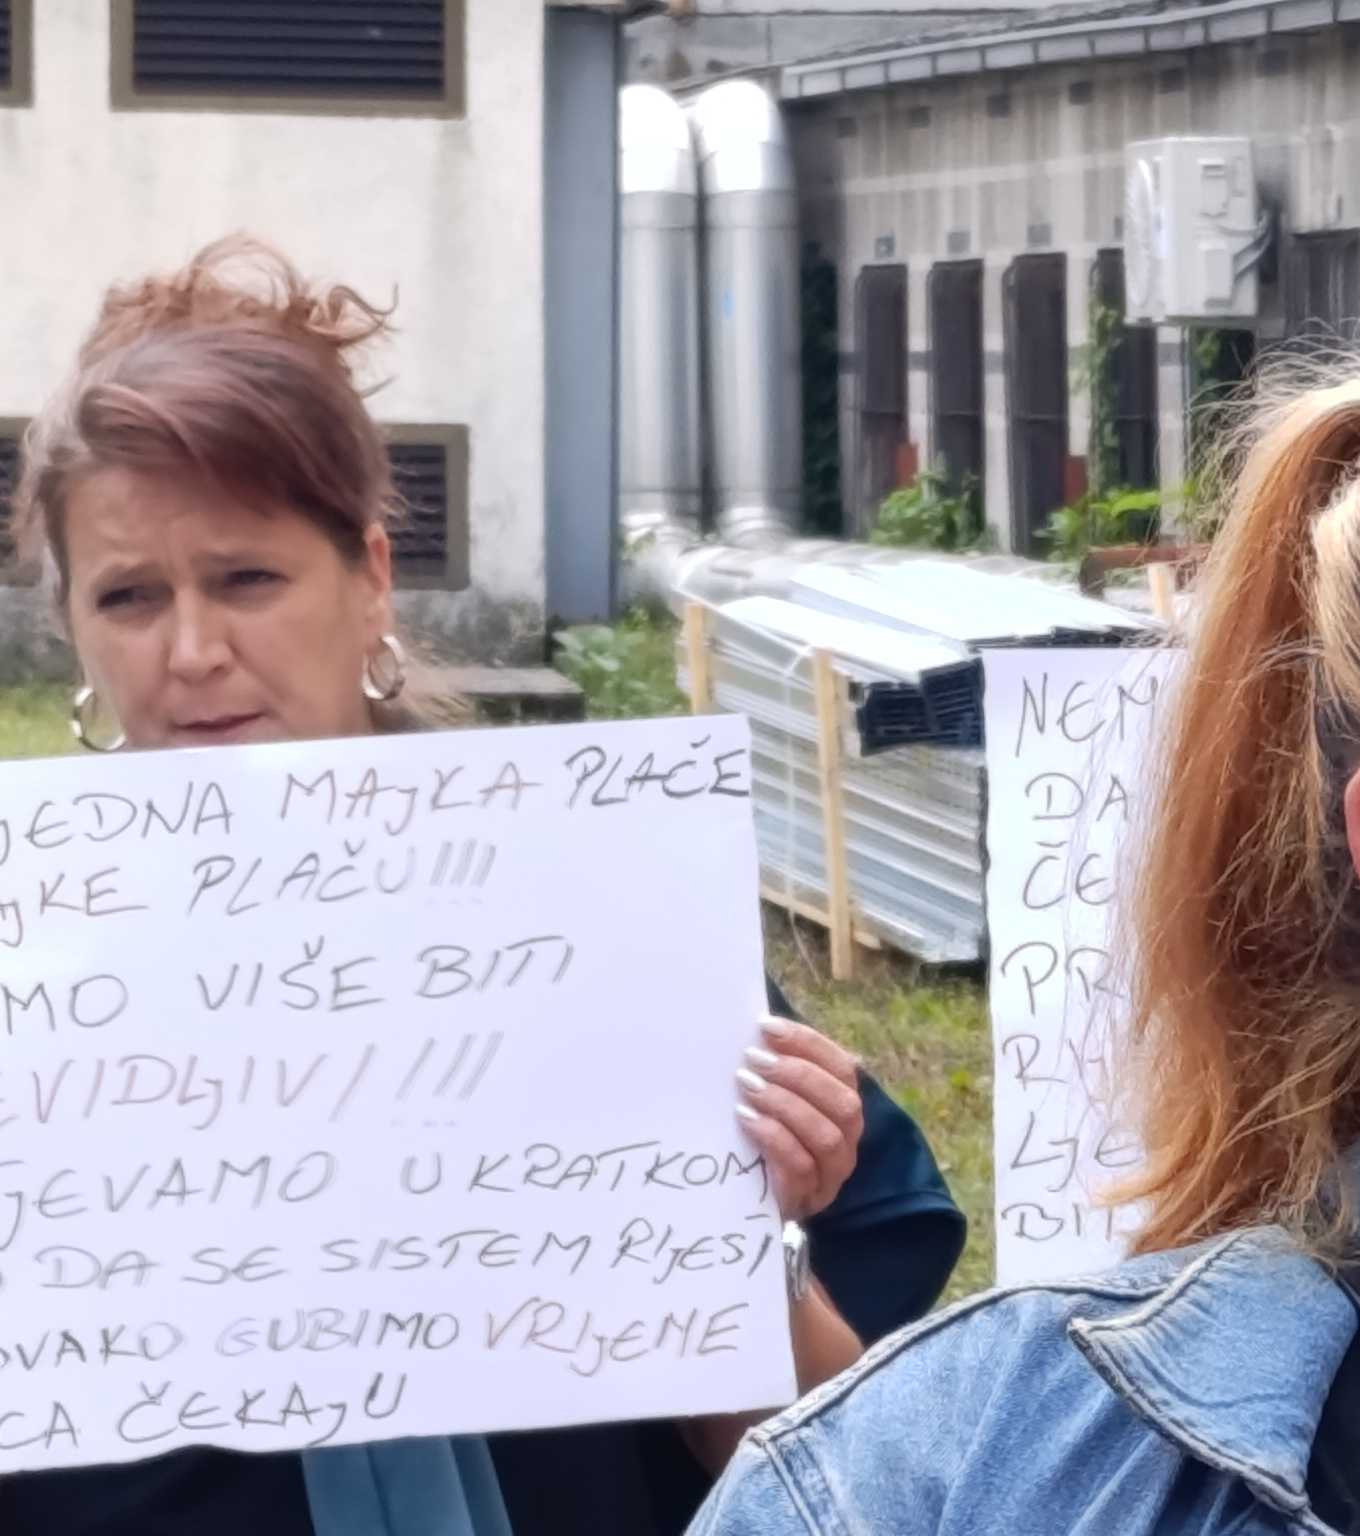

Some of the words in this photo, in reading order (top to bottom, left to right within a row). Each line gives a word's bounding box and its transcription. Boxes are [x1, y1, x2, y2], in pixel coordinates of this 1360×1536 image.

[278, 760, 542, 836] MAJKA
[564, 736, 750, 806] PLAČE
[0, 865, 148, 946] JKE
[195, 934, 384, 1012] VIŠE
[414, 934, 574, 1000] BITI
[400, 1153, 442, 1196] U
[466, 1140, 770, 1204] KRATKOM
[33, 1246, 160, 1290] DA
[180, 1246, 288, 1287] SE
[318, 1232, 592, 1276] SISTEM
[0, 1320, 186, 1372] VAKO
[214, 1306, 462, 1360] GUBIMO
[484, 1296, 750, 1378] VRIJEME
[116, 1370, 408, 1446] ČEKAJU
